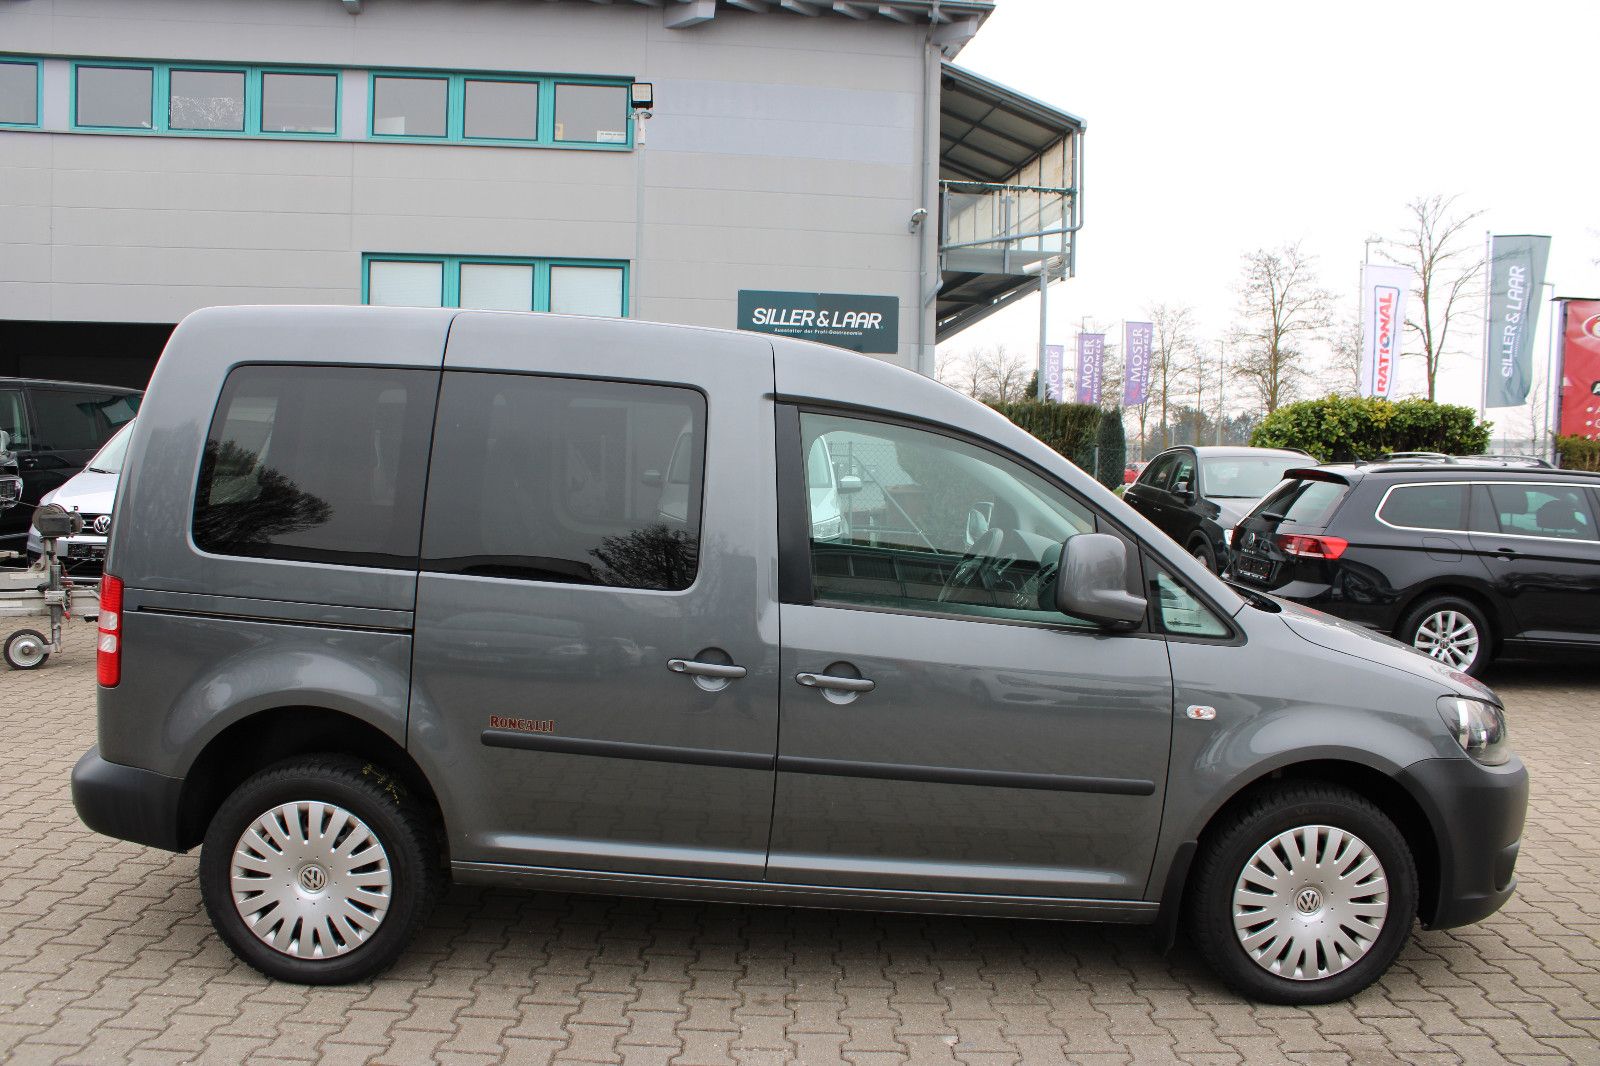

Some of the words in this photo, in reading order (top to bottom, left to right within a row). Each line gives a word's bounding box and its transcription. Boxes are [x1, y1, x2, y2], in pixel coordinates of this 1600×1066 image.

[1507, 265, 1525, 311] LAAR
[752, 307, 816, 327] SILLER
[816, 310, 830, 328] &
[831, 311, 882, 329] LAAR
[1377, 293, 1393, 392] RATIONAL
[1505, 312, 1521, 324] &
[1081, 339, 1094, 389] MOSER
[1093, 339, 1102, 404] TRACHTENWELT
[1130, 328, 1143, 382] MOSER
[1141, 328, 1150, 399] TRACHTENWELT
[1501, 325, 1517, 378] SILLER
[489, 713, 554, 733] RONCALLI
